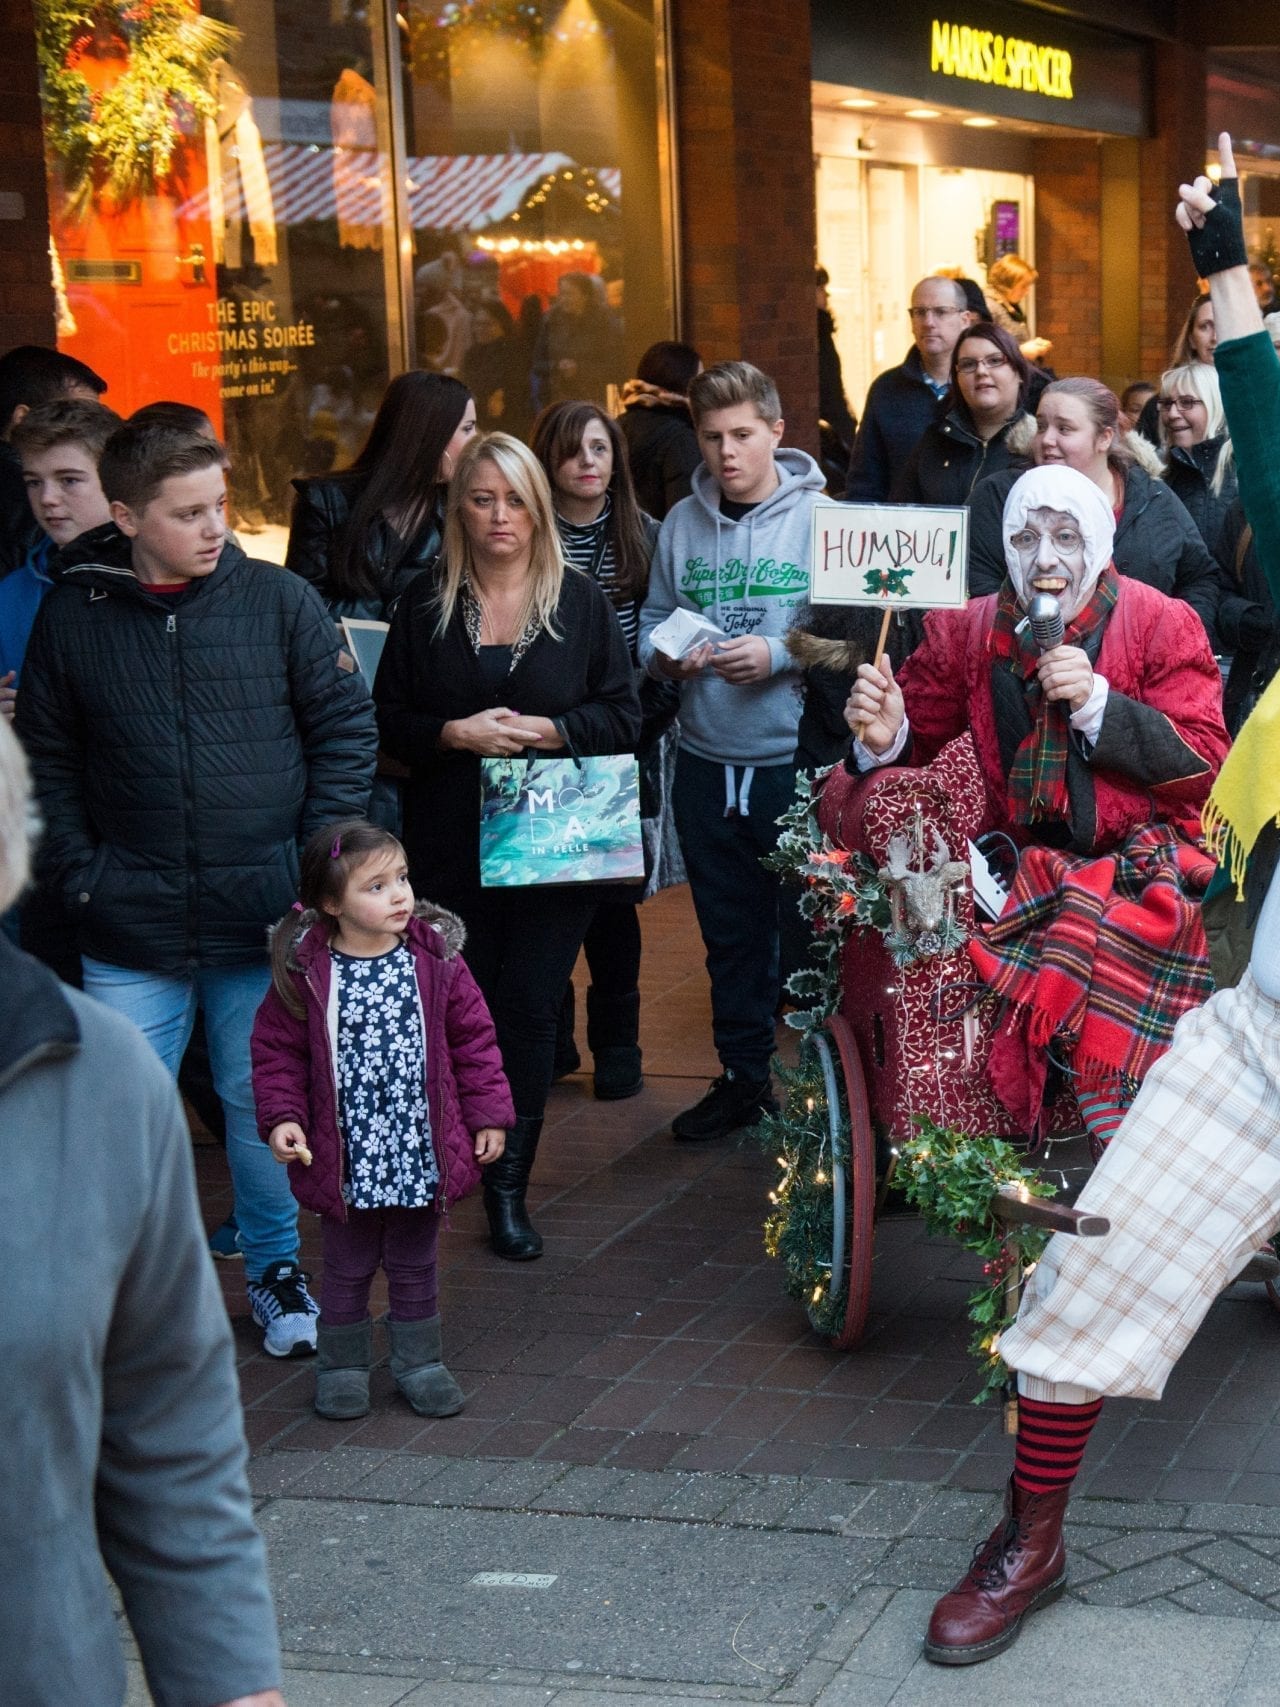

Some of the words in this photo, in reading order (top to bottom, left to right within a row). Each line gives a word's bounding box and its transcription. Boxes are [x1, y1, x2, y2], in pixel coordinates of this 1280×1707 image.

[206, 301, 237, 324] THE
[242, 300, 277, 322] EPIC
[167, 328, 258, 355] CHRISTMAS
[263, 319, 316, 348] SOIRÉE
[192, 361, 209, 378] The
[211, 358, 247, 381] party's
[249, 356, 267, 373] this
[219, 385, 244, 399] come
[246, 383, 259, 396] on
[823, 527, 958, 581] HUMBUG!
[532, 846, 546, 855] IN
[553, 843, 589, 854] PELLE
